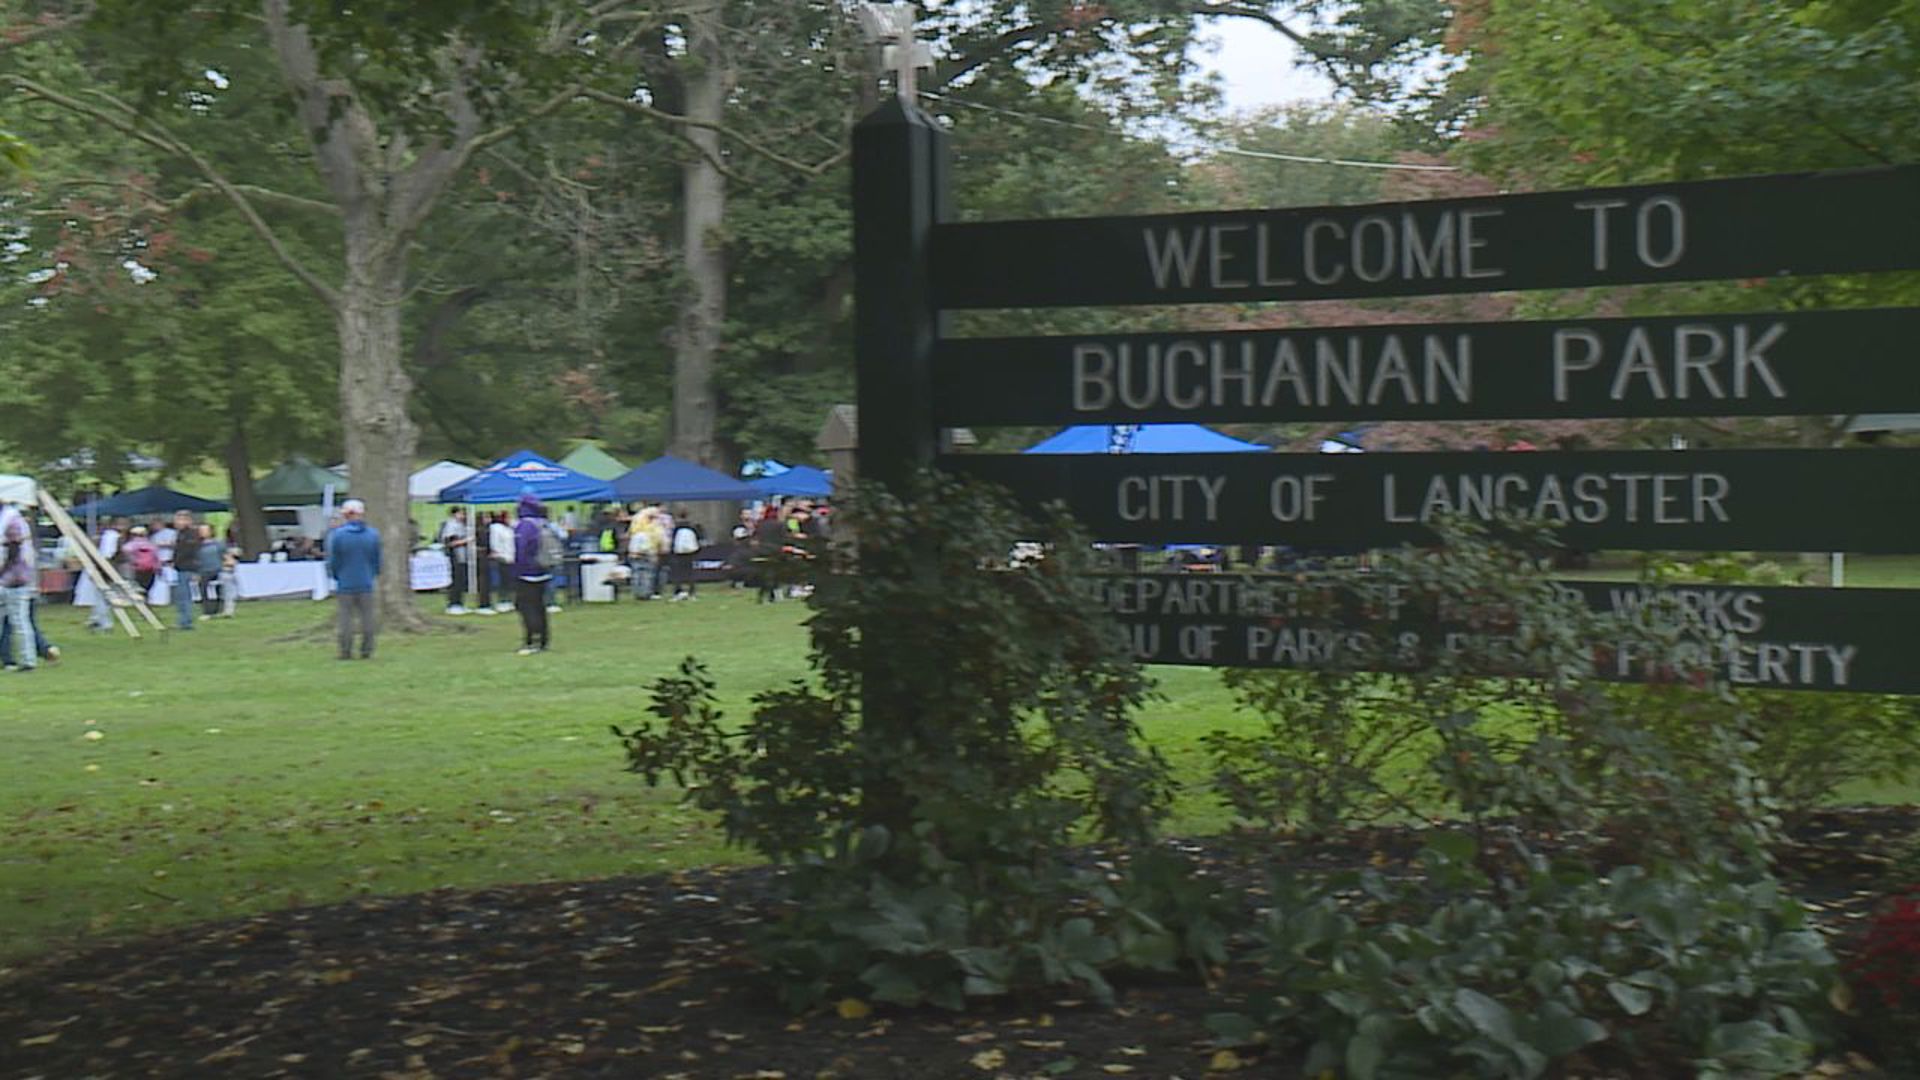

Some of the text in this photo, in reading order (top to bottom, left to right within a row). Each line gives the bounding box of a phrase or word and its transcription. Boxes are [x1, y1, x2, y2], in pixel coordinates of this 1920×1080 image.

[1142, 195, 1686, 289] WELCOME TO
[1072, 321, 1788, 411] BUCHANAN PARK
[1117, 472, 1730, 523] CITY OF LANCASTER
[1180, 623, 1228, 660] OF
